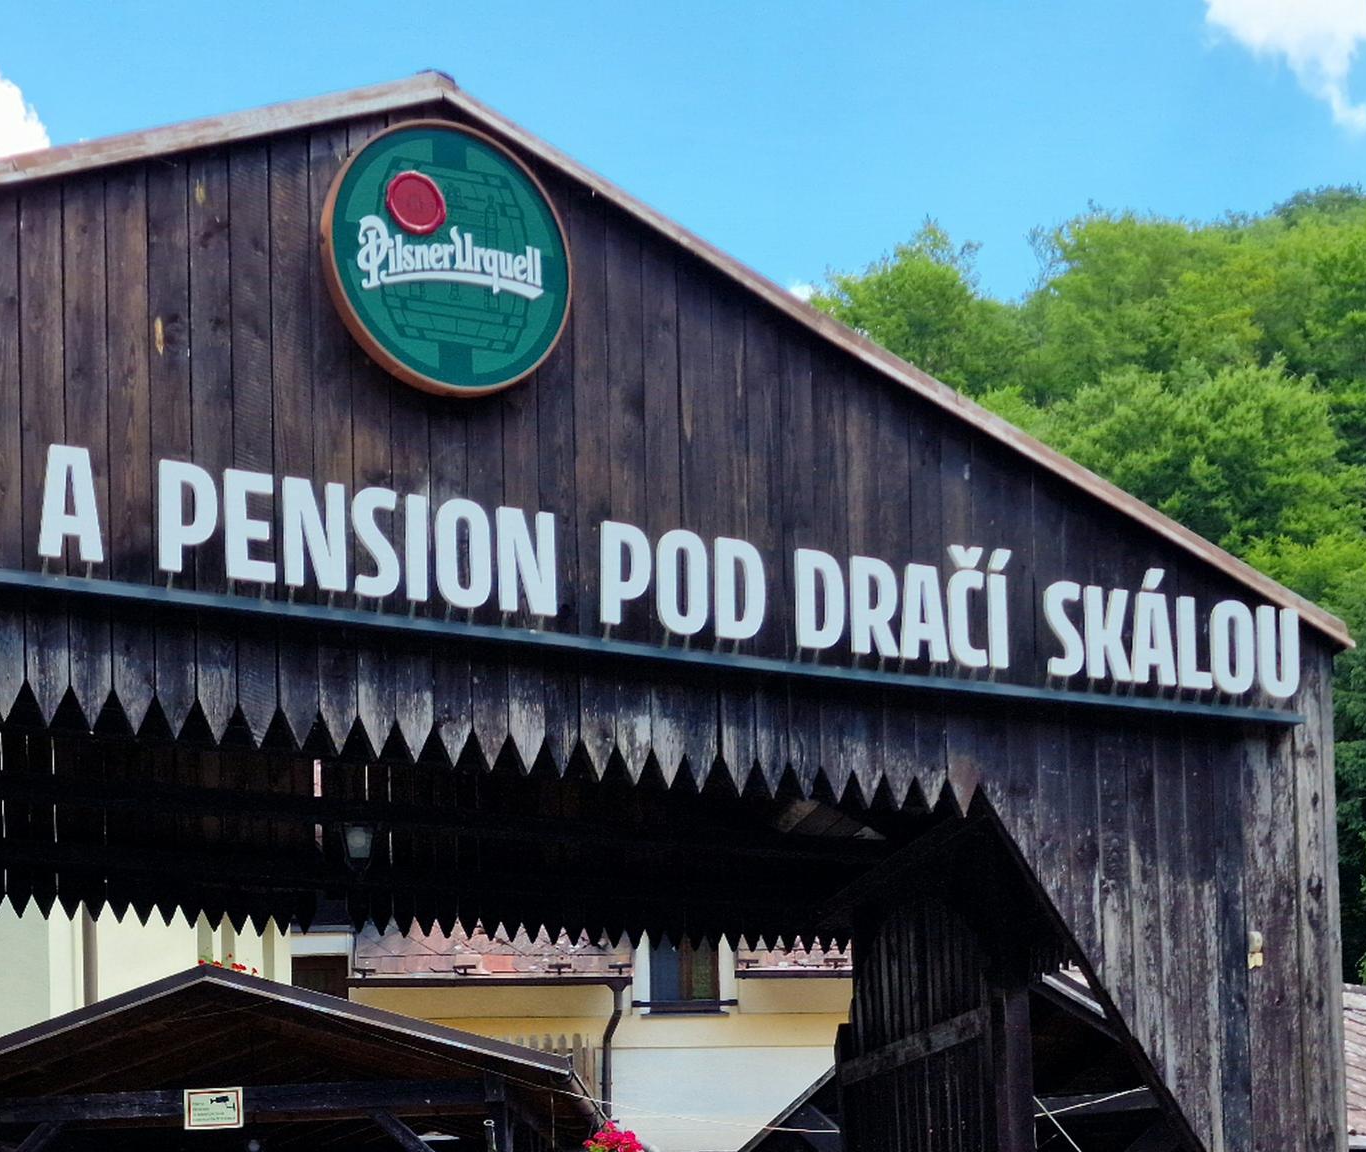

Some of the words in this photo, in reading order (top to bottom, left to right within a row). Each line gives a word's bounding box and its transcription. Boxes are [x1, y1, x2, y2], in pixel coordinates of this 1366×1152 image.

[357, 215, 454, 290] Pilsner
[450, 225, 543, 295] Urquell
[38, 443, 104, 563] A
[158, 458, 558, 617] PENSION
[599, 520, 766, 640] POD
[795, 544, 1012, 669] DRAČÍ
[1044, 568, 1300, 698] SKÁLOU
